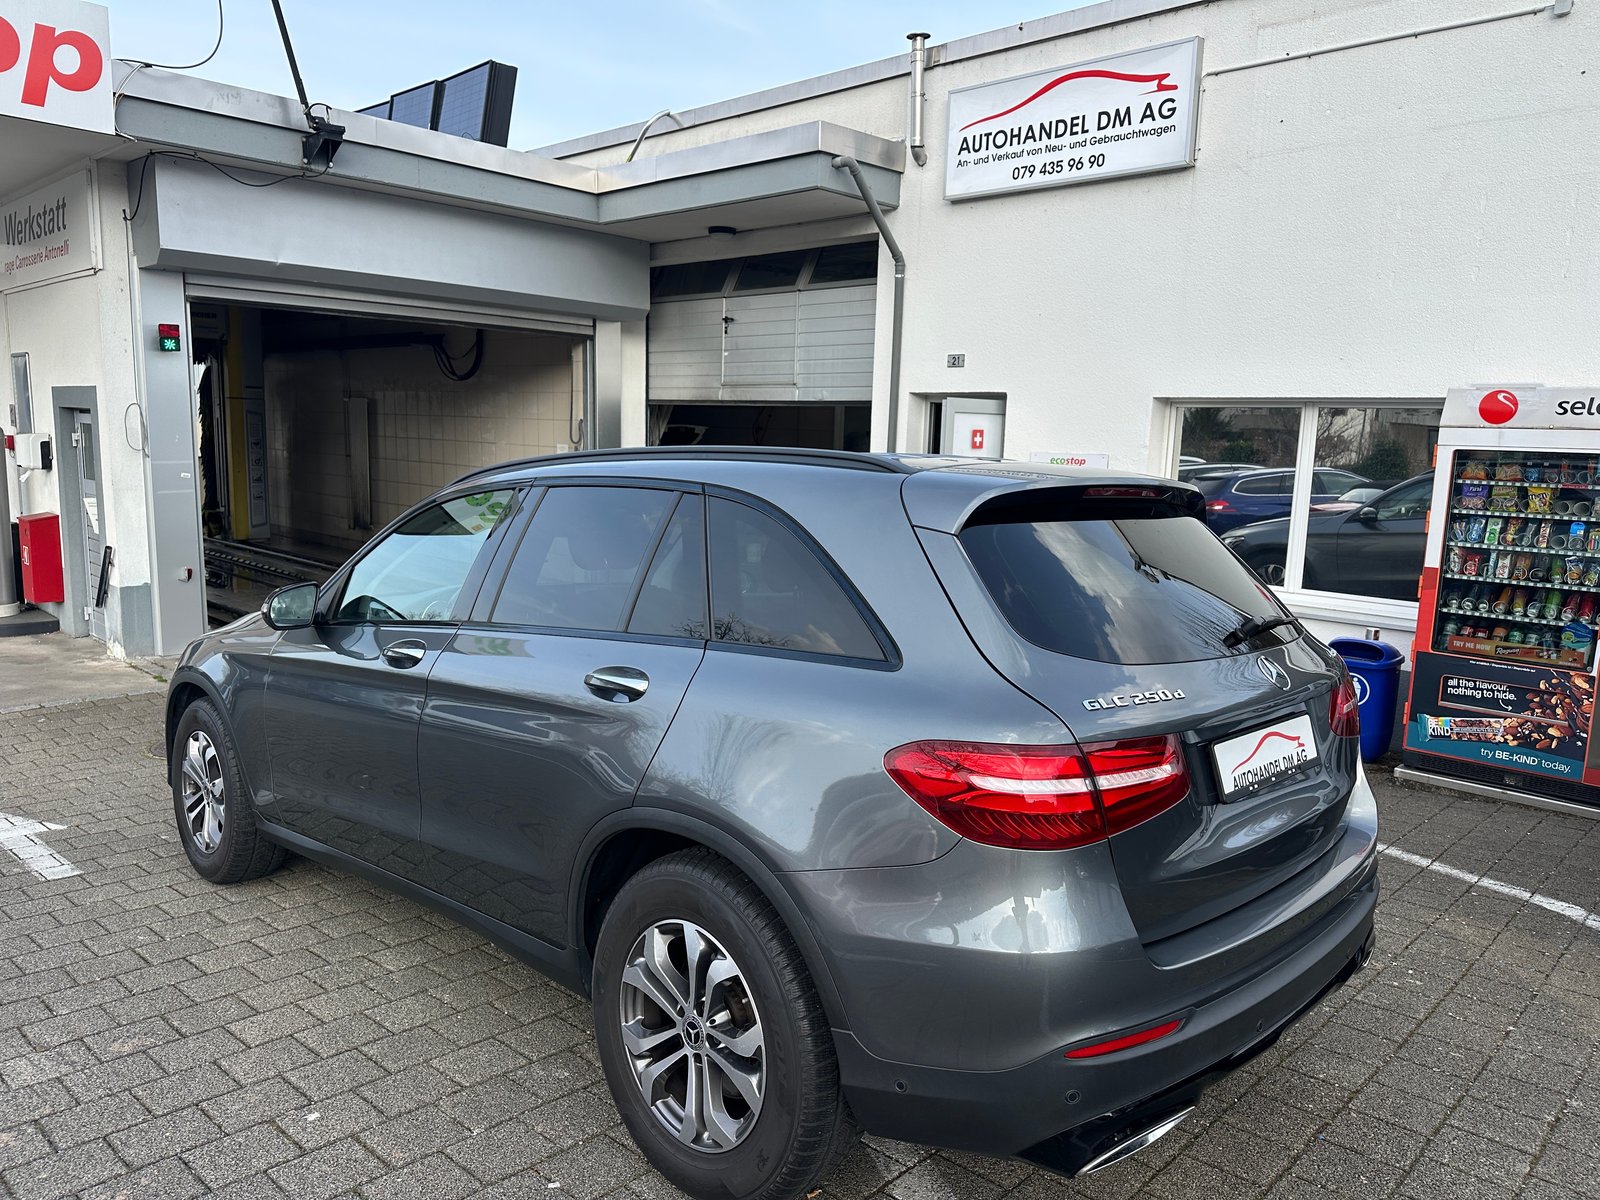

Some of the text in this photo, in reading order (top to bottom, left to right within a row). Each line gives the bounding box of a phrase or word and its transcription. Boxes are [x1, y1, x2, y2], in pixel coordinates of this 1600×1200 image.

[958, 98, 1178, 156] AUTOHANDEL DM AG
[956, 124, 1177, 169] An- und Verkauf von Neu- und Gebrauchtwagen
[1012, 152, 1106, 180] 079 435 96 90
[4, 195, 67, 246] Werkstatt
[951, 356, 960, 366] 21
[1050, 456, 1087, 467] ecostop
[1453, 640, 1491, 651] TRY ME NOW
[1447, 678, 1510, 692] all the flavour.
[1447, 687, 1517, 701] nothing to hide.
[1082, 695, 1130, 711] GLC
[1428, 726, 1451, 736] KIND
[1480, 747, 1494, 759] try
[1541, 760, 1572, 774] today.
[1233, 748, 1309, 791] AUTOHANDEL DM AG
